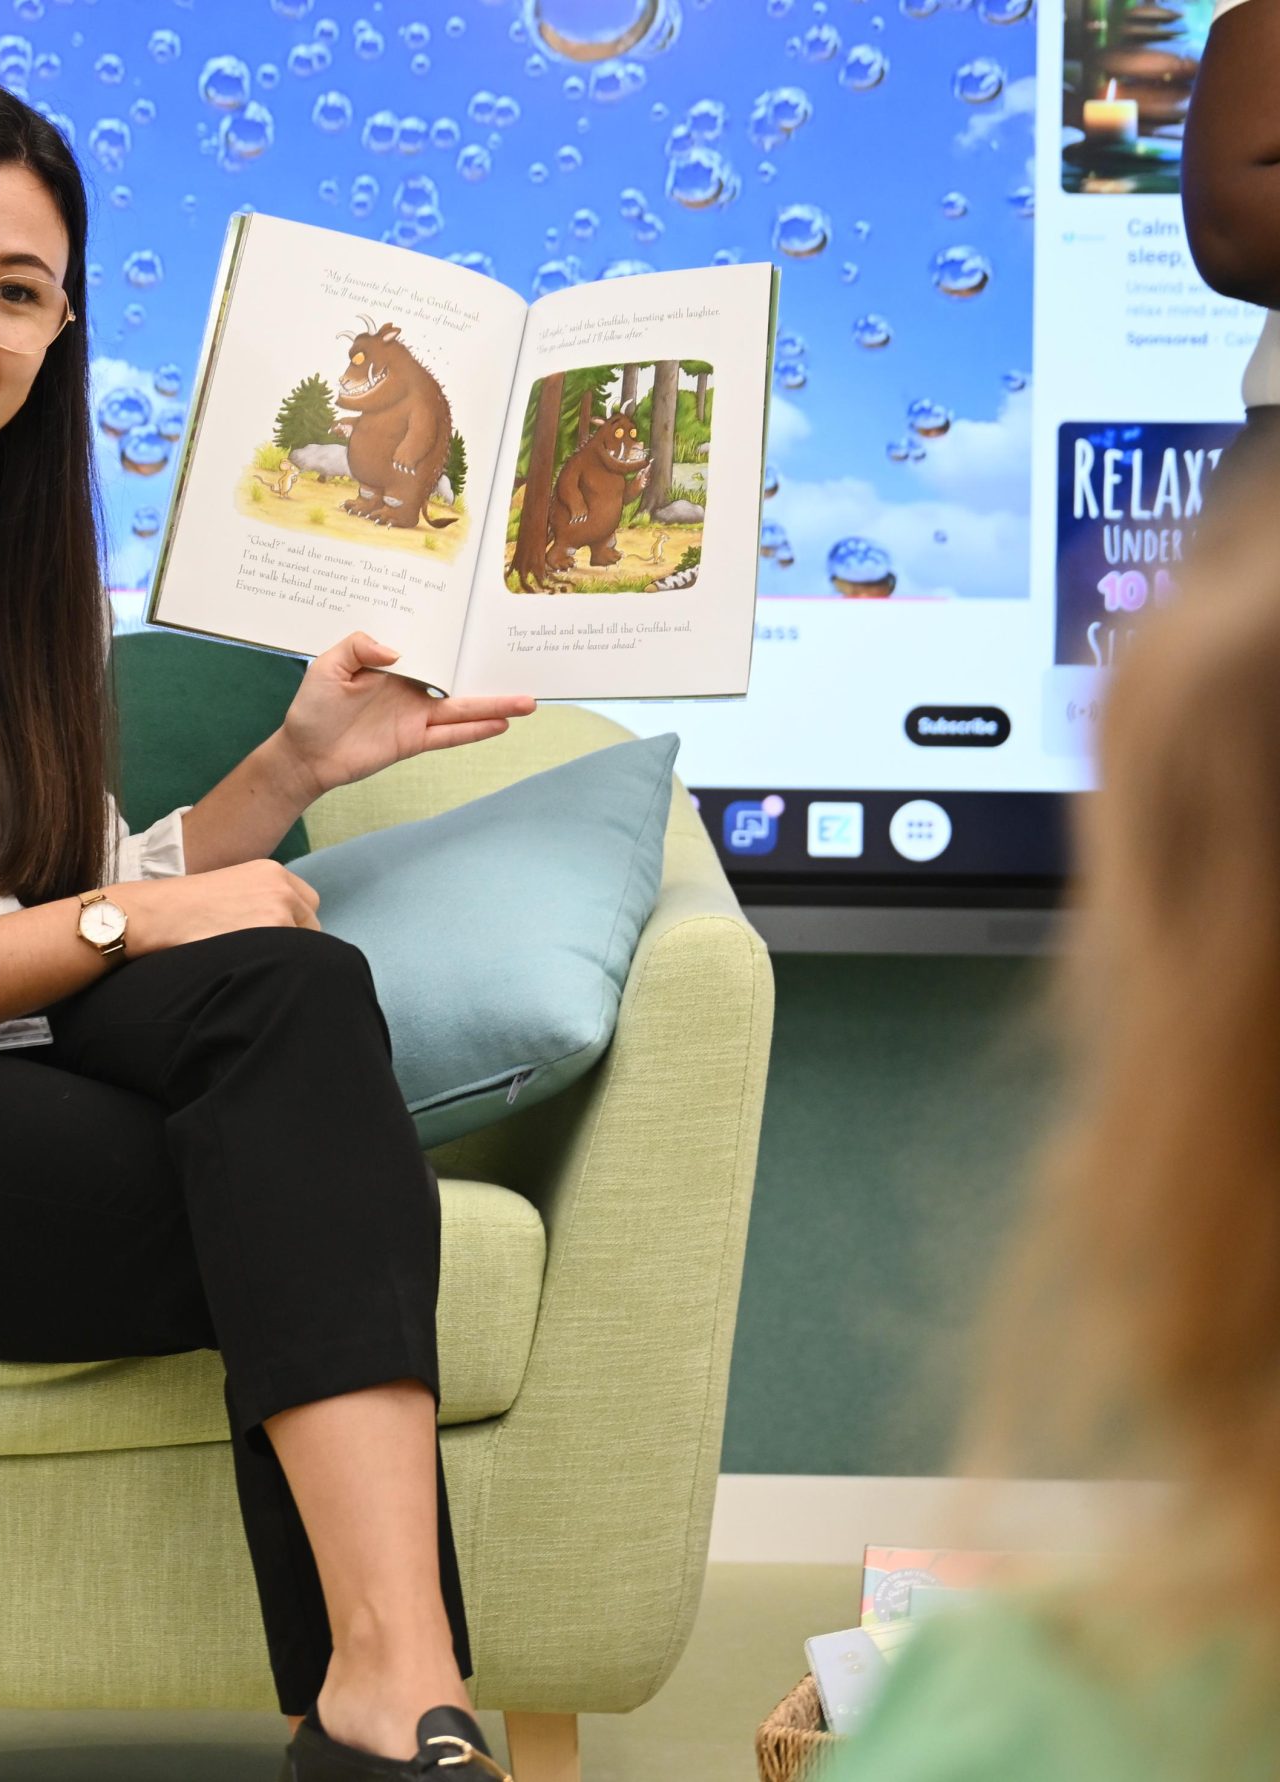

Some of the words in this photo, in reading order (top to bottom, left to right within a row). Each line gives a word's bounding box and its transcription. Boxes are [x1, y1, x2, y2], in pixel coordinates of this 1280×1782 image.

[1126, 218, 1180, 238] Calm
[342, 272, 380, 291] favourite
[410, 290, 424, 303] the
[426, 296, 463, 315] Gruffalo
[348, 292, 369, 304] taste
[369, 298, 393, 310] good
[392, 304, 403, 313] on
[412, 307, 431, 321] slice
[431, 313, 443, 326] of
[569, 319, 584, 332] said
[584, 318, 596, 330] the
[632, 311, 665, 326] bursting
[666, 306, 685, 320] with
[576, 332, 592, 346] and
[602, 330, 624, 346] follow
[1073, 437, 1224, 520] RELAX
[1104, 524, 1184, 565] UNDER
[243, 549, 258, 561] I'm
[261, 552, 276, 565] the
[278, 561, 309, 574] scariest
[312, 568, 348, 583] creature
[350, 574, 360, 585] in
[363, 575, 380, 588] this
[382, 584, 407, 598] wood.
[247, 534, 286, 550] "Good?"
[287, 545, 306, 556] said
[307, 547, 322, 560] the
[324, 555, 356, 568] mouse.
[359, 559, 389, 576] "Don't
[391, 568, 408, 581] call
[409, 576, 422, 585] me
[424, 580, 447, 594] good!
[235, 578, 276, 597] Everyone
[279, 589, 287, 600] is
[288, 591, 315, 607] afraid
[316, 597, 328, 609] of
[329, 602, 352, 614] me."
[238, 563, 257, 577] Just
[259, 569, 280, 582] walk
[281, 571, 312, 590] behind
[314, 583, 328, 593] me
[330, 586, 348, 598] and
[349, 592, 370, 603] soon
[371, 597, 399, 610] you'll
[399, 605, 416, 617] see,
[1097, 569, 1149, 613] 10
[507, 624, 529, 640] They
[530, 623, 558, 637] walked
[559, 623, 576, 636] and
[576, 622, 605, 636] walked
[606, 621, 619, 635] till
[620, 621, 634, 635] the
[636, 620, 672, 634] Gruffalo
[516, 640, 535, 652] hear
[543, 640, 560, 652] hiss
[561, 642, 571, 651] in
[571, 639, 585, 651] the
[586, 639, 609, 651] leaves
[753, 621, 799, 641] lass
[917, 715, 999, 736] Subscribe
